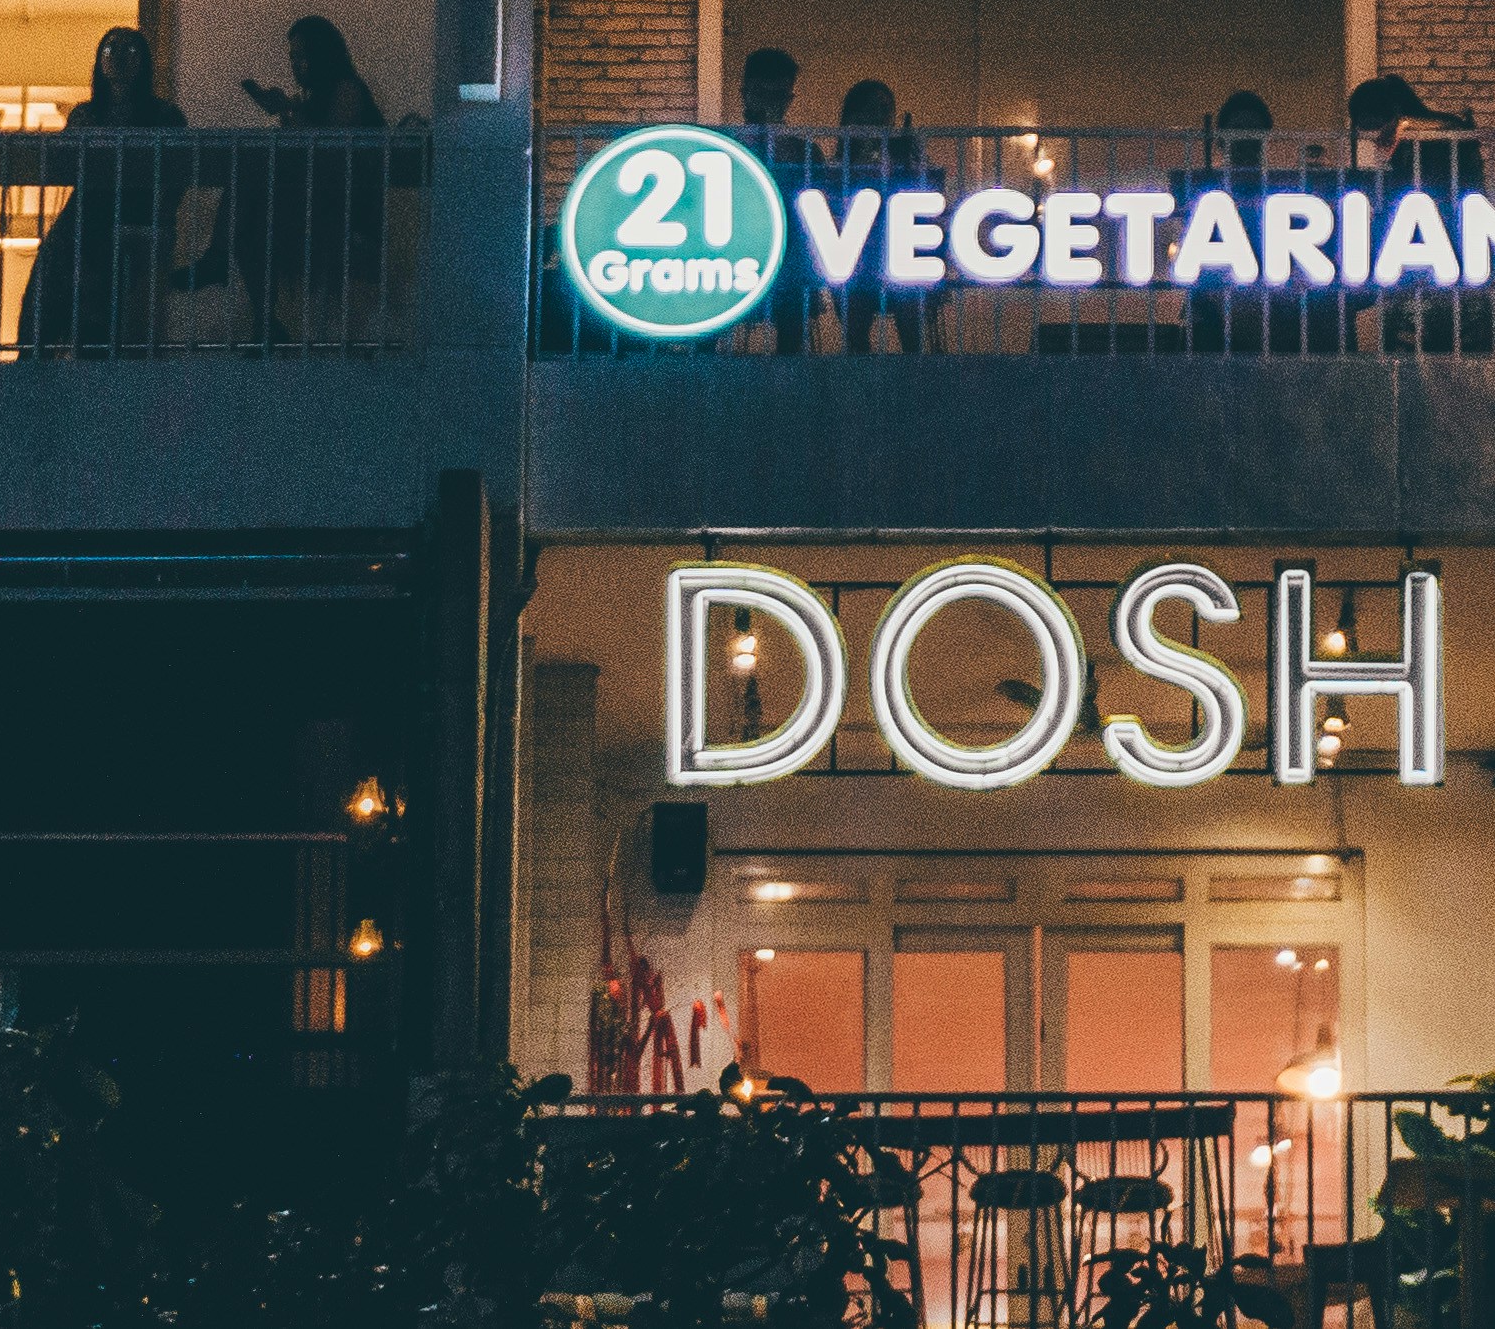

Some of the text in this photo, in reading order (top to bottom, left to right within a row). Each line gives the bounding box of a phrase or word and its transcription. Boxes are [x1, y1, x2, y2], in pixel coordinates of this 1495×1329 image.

[615, 148, 734, 248] 21
[588, 249, 761, 295] Grams
[665, 557, 1445, 789] DOSH
